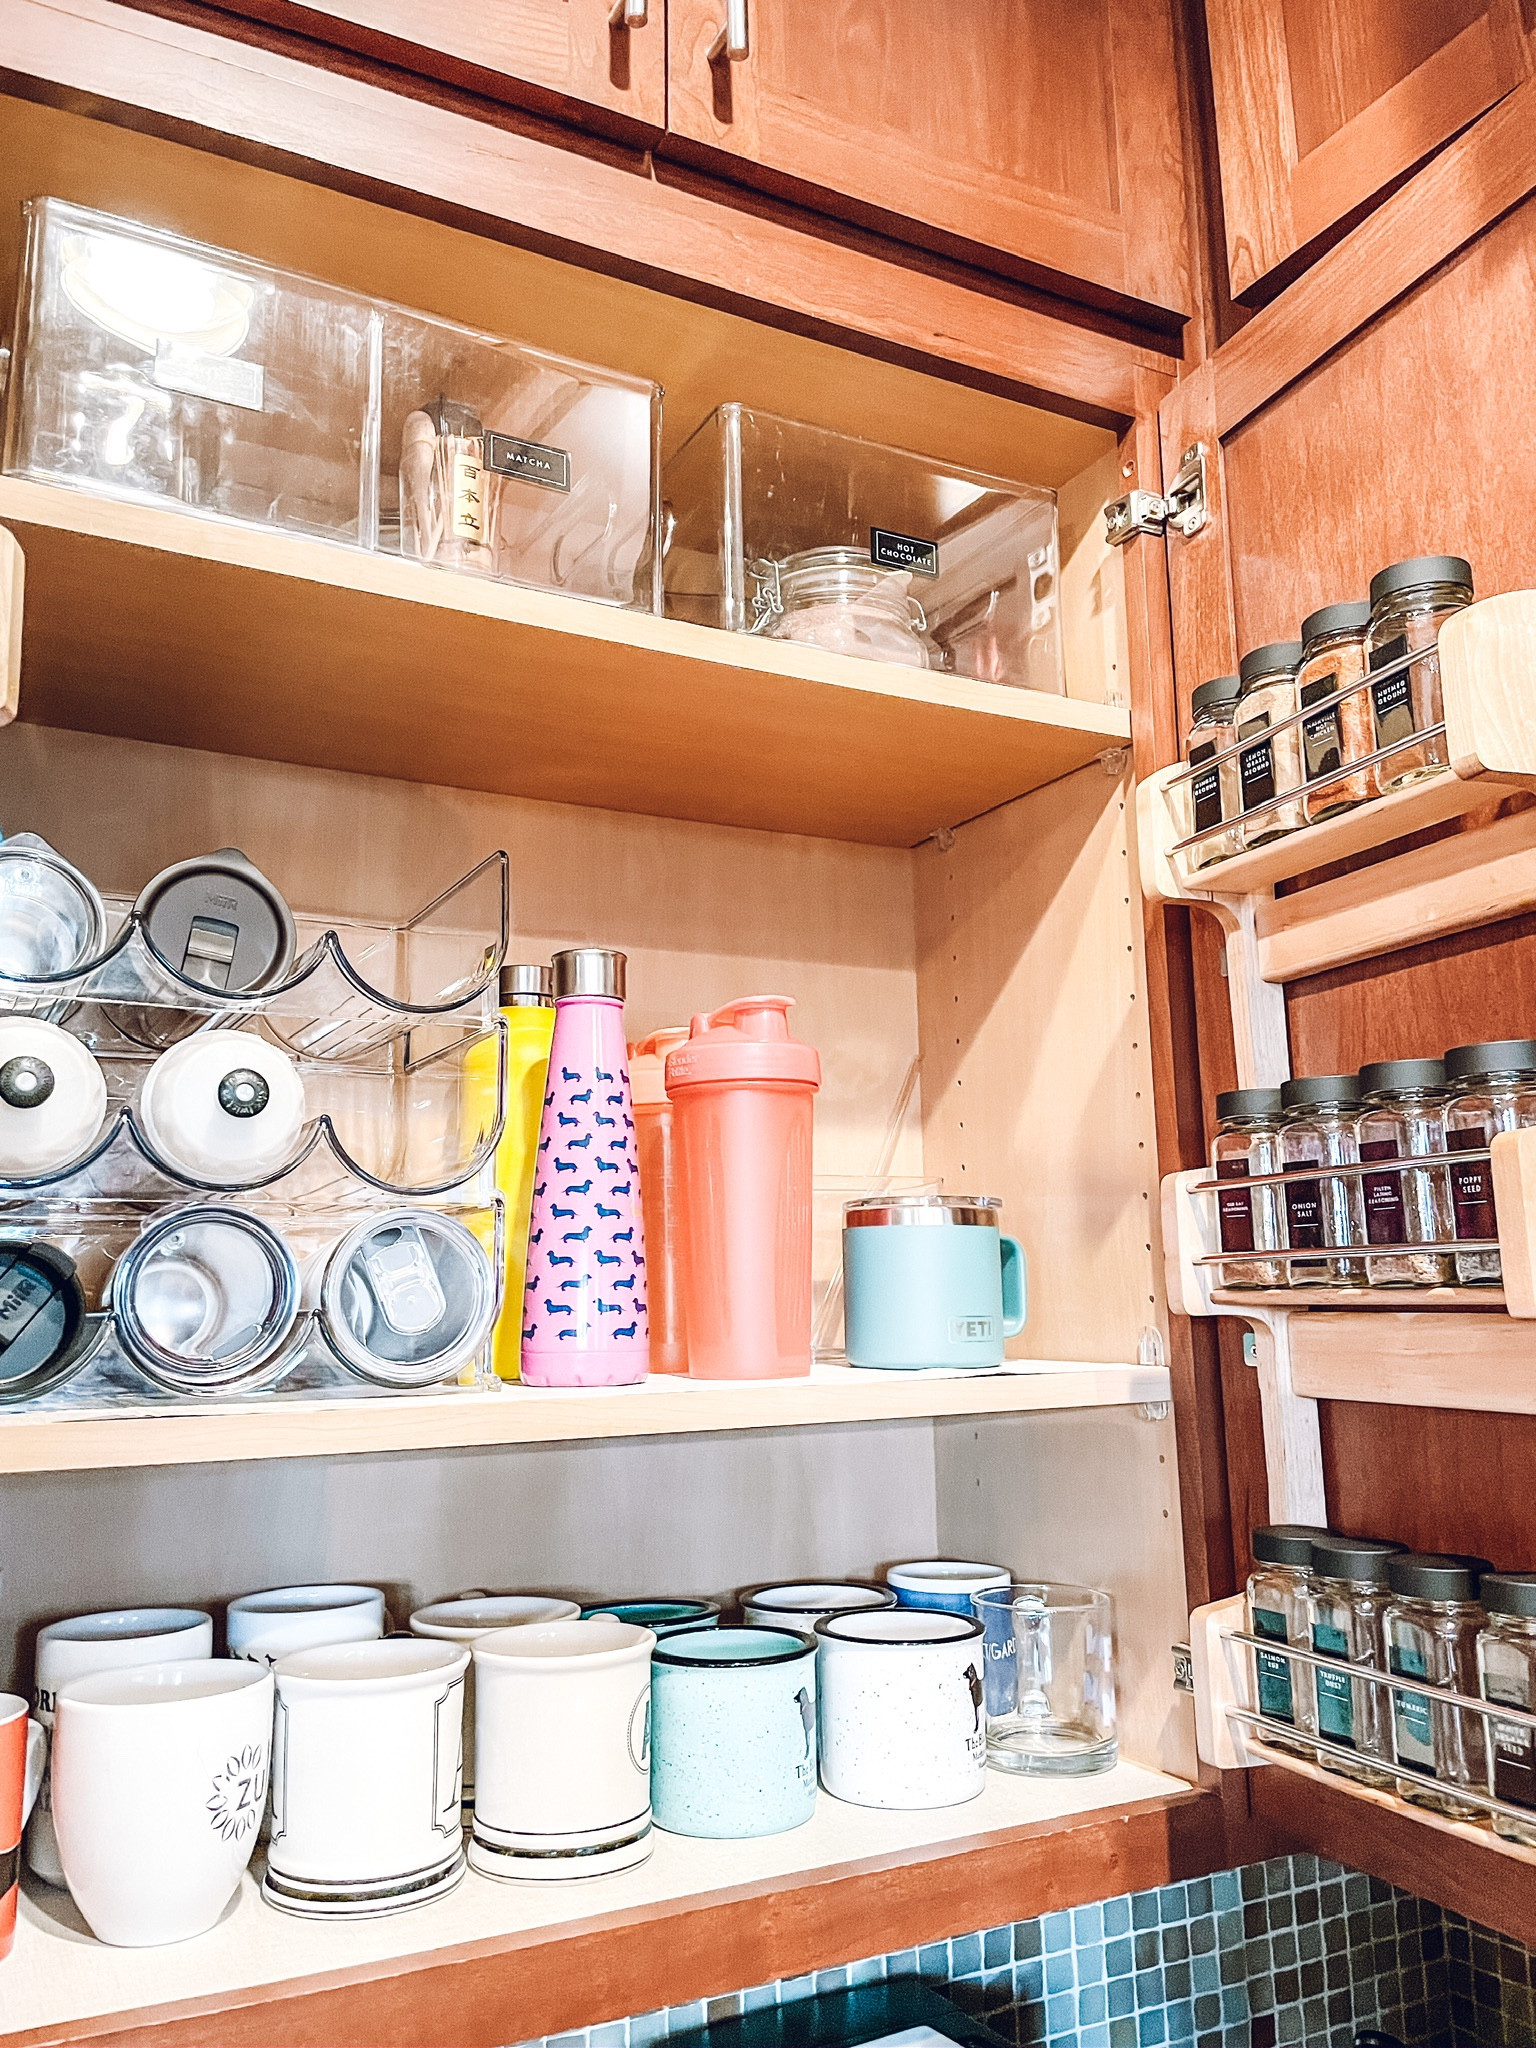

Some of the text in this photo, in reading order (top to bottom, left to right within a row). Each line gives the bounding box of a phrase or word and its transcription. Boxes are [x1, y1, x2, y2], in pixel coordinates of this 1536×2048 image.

[506, 452, 551, 470] MATCHA
[897, 543, 915, 554] HOT
[880, 547, 932, 566] CHOCOLATE
[1377, 680, 1406, 698] NUTMEG
[1377, 686, 1407, 705] GROUND
[1245, 748, 1266, 763] LEMON
[1246, 755, 1266, 768] GRASS
[1244, 760, 1270, 776] GROUND
[1458, 1175, 1482, 1185] POPPY
[1462, 1184, 1482, 1194] SEED
[1291, 1202, 1317, 1210] ONION
[1297, 1210, 1313, 1218] SALT
[955, 1321, 993, 1337] YETI
